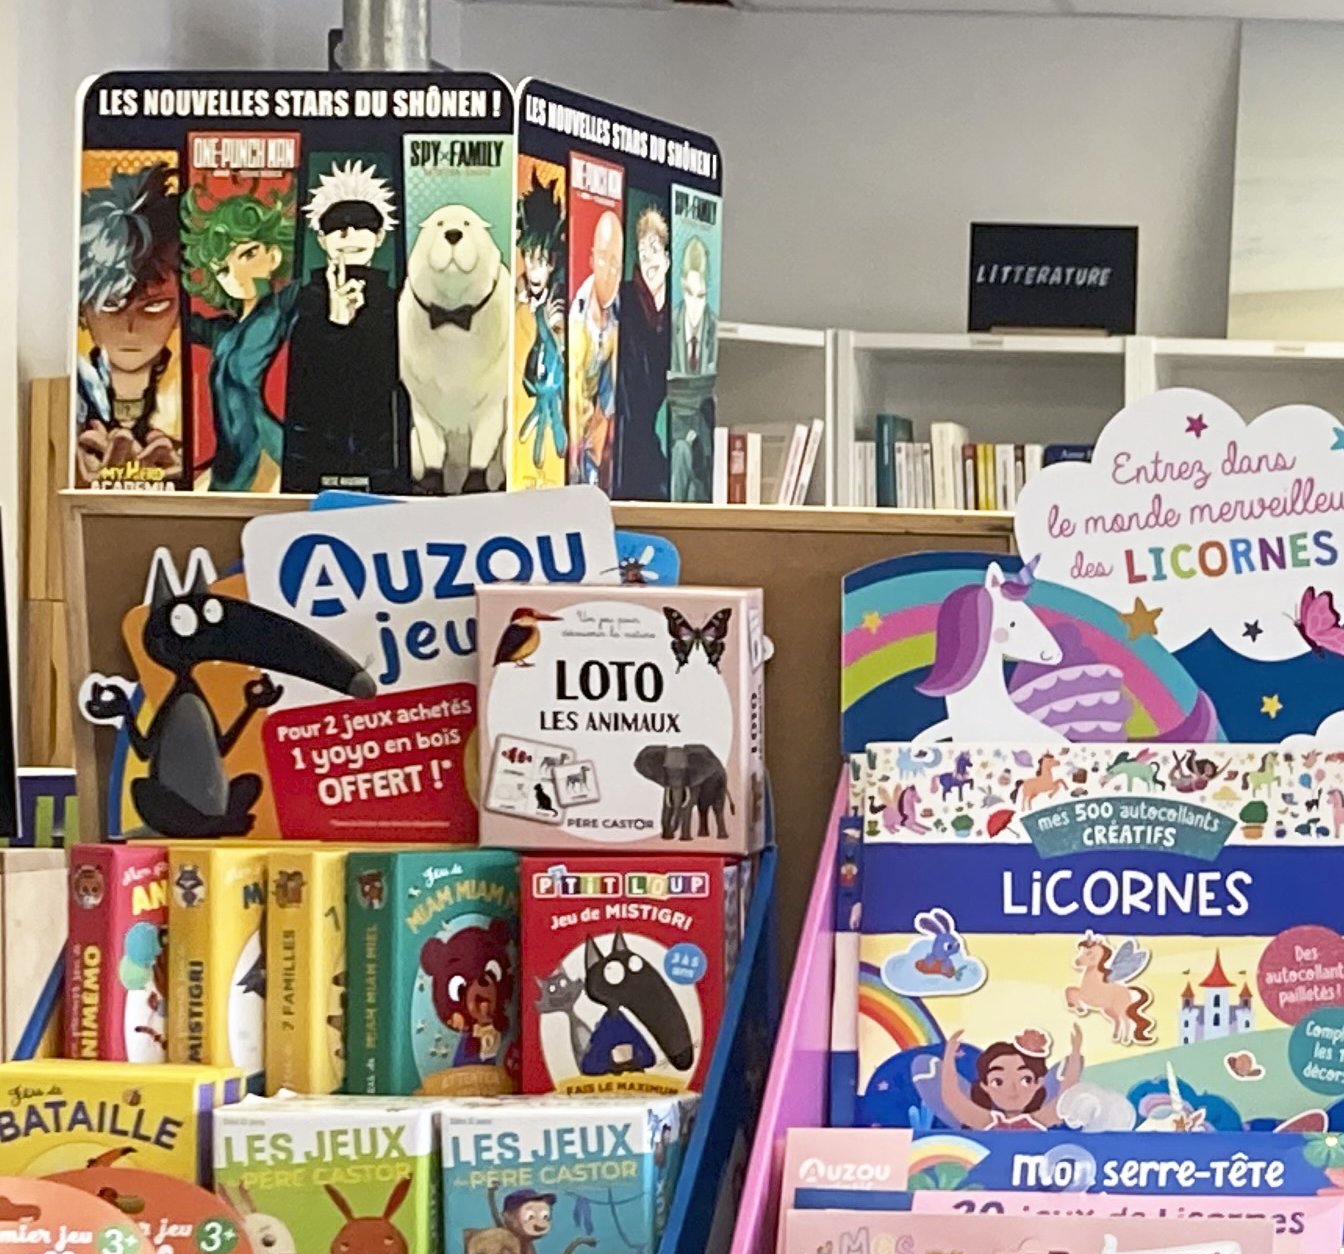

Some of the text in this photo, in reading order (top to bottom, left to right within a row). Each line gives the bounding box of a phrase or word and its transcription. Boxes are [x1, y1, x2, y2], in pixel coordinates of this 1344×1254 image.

[99, 88, 138, 116] LES
[143, 88, 281, 117] NOUVELLES
[284, 88, 351, 117] STARS
[354, 88, 387, 117] DU
[393, 84, 487, 117] SHÔNEN
[525, 94, 547, 126] LES
[547, 101, 611, 147] NOUVELLES
[611, 122, 649, 159] STARS
[649, 134, 667, 163] DU
[1111, 441, 1297, 488] Entrez dans
[1046, 504, 1077, 540] le
[1083, 488, 1181, 536] monde
[1069, 551, 1114, 583] des
[1123, 538, 1339, 586] LICORNES
[556, 659, 665, 704] LOTO
[276, 698, 473, 742] Pour 2 jeux achetés
[539, 710, 682, 733] LES ANIMAUX
[290, 728, 462, 775] 1 yoyo en bois
[318, 764, 424, 806] OFFERT
[602, 818, 654, 831] CASTOR
[1038, 801, 1220, 834] mes 500 autocollants
[1082, 822, 1177, 848] CRÉATIFS
[550, 902, 694, 931] Jeu de MISTIGRI
[283, 929, 296, 1016] FAMILLES
[1314, 1041, 1333, 1061] les
[0, 1100, 183, 1151] BATAILLE
[223, 1124, 407, 1167] LES JEUX
[452, 1123, 633, 1168] LES JEUX
[541, 1159, 638, 1185] CASTOR
